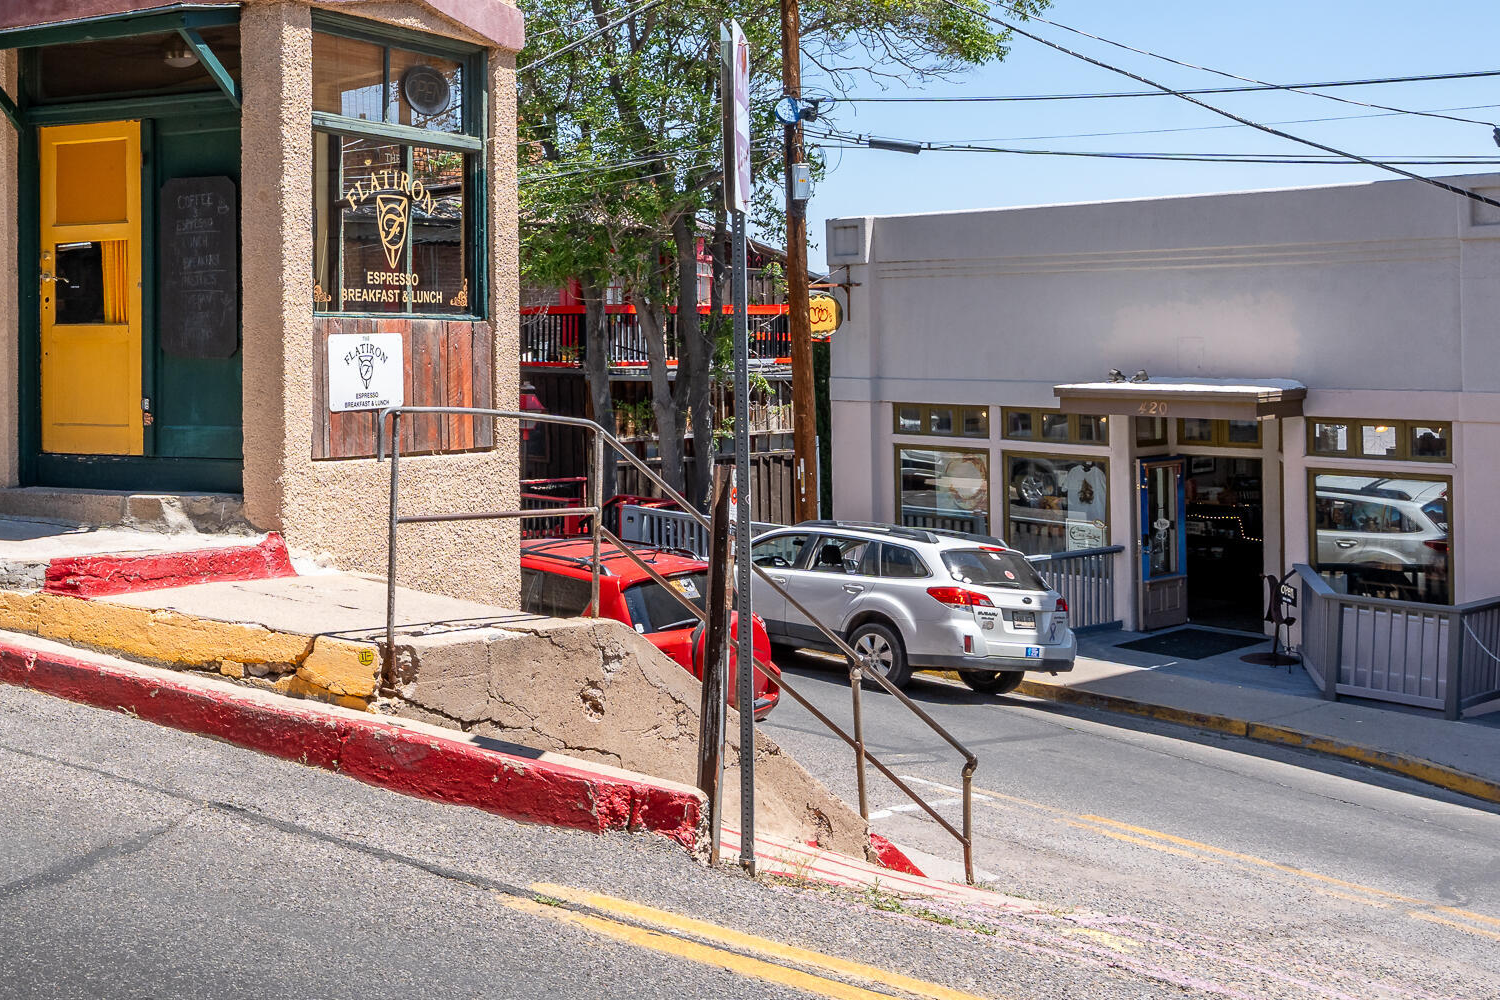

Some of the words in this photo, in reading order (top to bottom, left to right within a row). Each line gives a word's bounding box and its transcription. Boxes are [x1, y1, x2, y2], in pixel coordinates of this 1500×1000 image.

[385, 152, 401, 163] THE
[345, 169, 437, 216] FLATIRON
[177, 192, 214, 209] COFFEE
[366, 271, 419, 286] ESPRESSO
[342, 288, 400, 303] BREAKFAST
[402, 290, 409, 303] &
[411, 290, 443, 304] LUNCH
[344, 343, 388, 366] FLATIRON
[344, 399, 370, 409] BREAKFAST
[375, 399, 390, 407] LUNCH
[1138, 401, 1168, 416] 420
